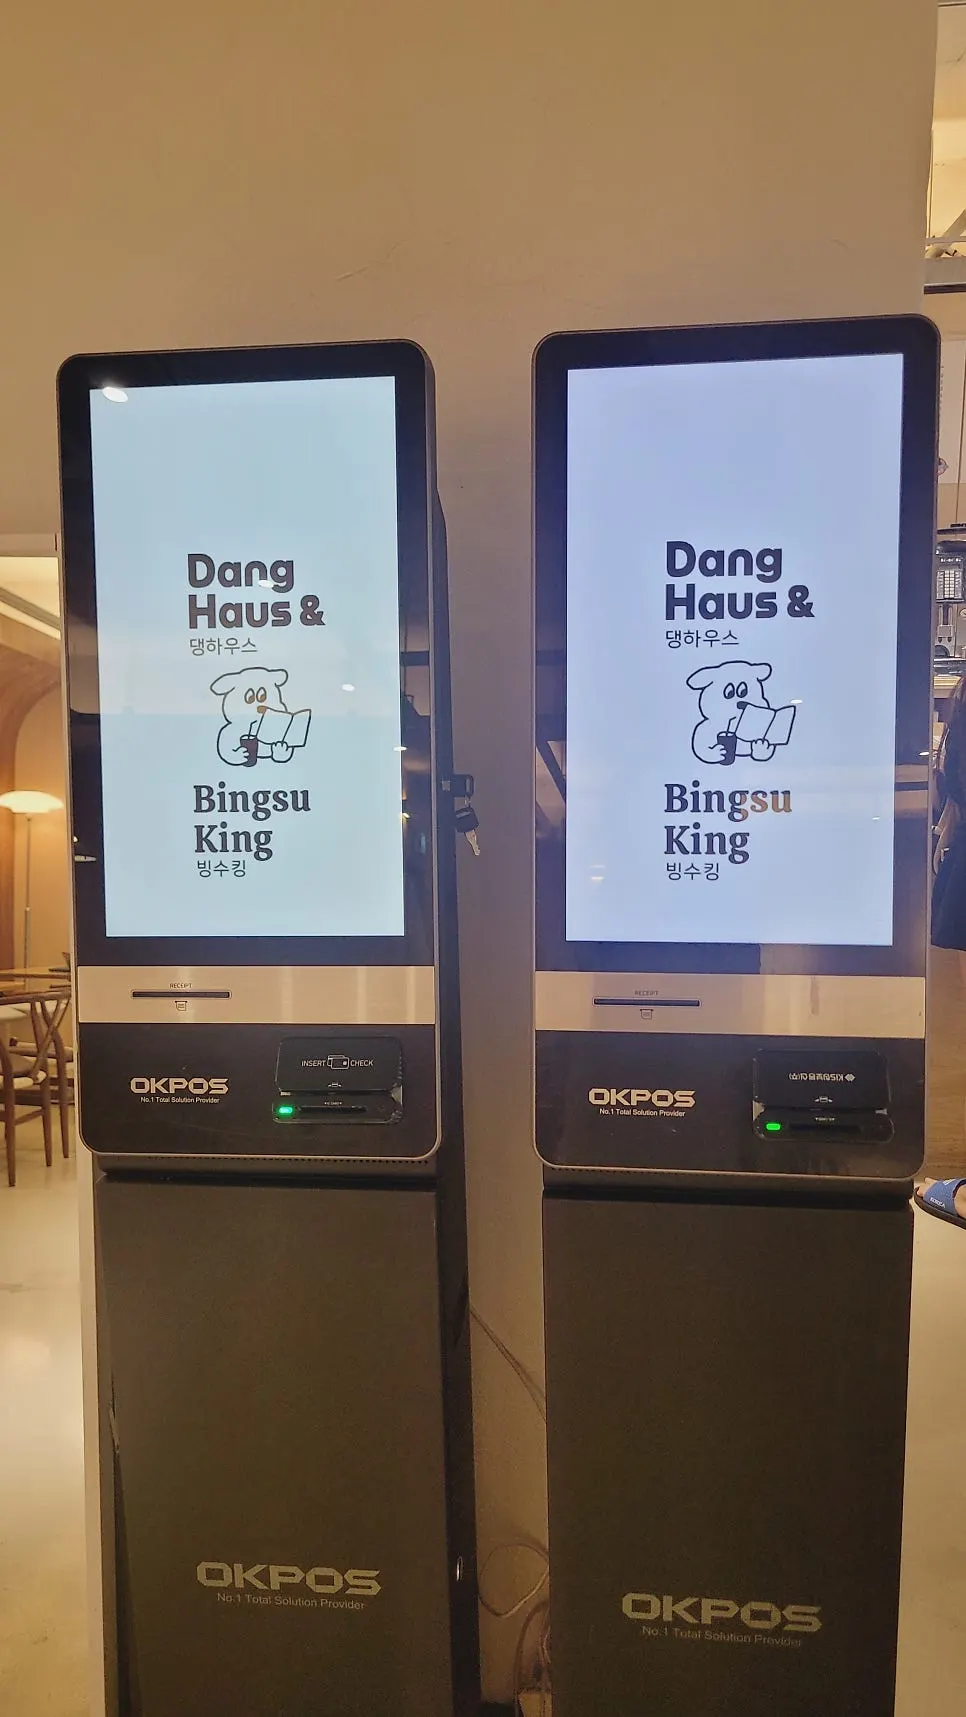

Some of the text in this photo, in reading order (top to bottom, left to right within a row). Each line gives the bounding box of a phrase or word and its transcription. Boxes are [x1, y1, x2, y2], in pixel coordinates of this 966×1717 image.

[187, 553, 295, 593] Dang
[665, 540, 783, 583] Dang
[188, 594, 326, 629] Haus &
[665, 583, 815, 621] Haus &
[189, 637, 258, 657] 댕하우스
[665, 629, 740, 649] 댕하우스
[193, 781, 312, 822] Bingsu
[664, 780, 793, 823] Bingsu
[194, 821, 274, 862] King
[664, 822, 751, 865] King
[197, 860, 247, 878] 빙수킹
[665, 863, 720, 881] 빙수킹
[130, 1077, 229, 1095] OKPOS
[588, 1088, 696, 1108] OKPOS
[171, 1096, 195, 1104] Solution
[195, 1096, 220, 1104] Provider
[616, 1108, 632, 1116] Total
[632, 1109, 658, 1117] Solution
[196, 1561, 382, 1596] OKPOS
[217, 1592, 365, 1610] No.1 Total Solution Provider
[622, 1592, 822, 1632] OKPOS
[673, 1627, 701, 1639] Total
[704, 1630, 751, 1643] Solution
[754, 1634, 802, 1647] Provider
